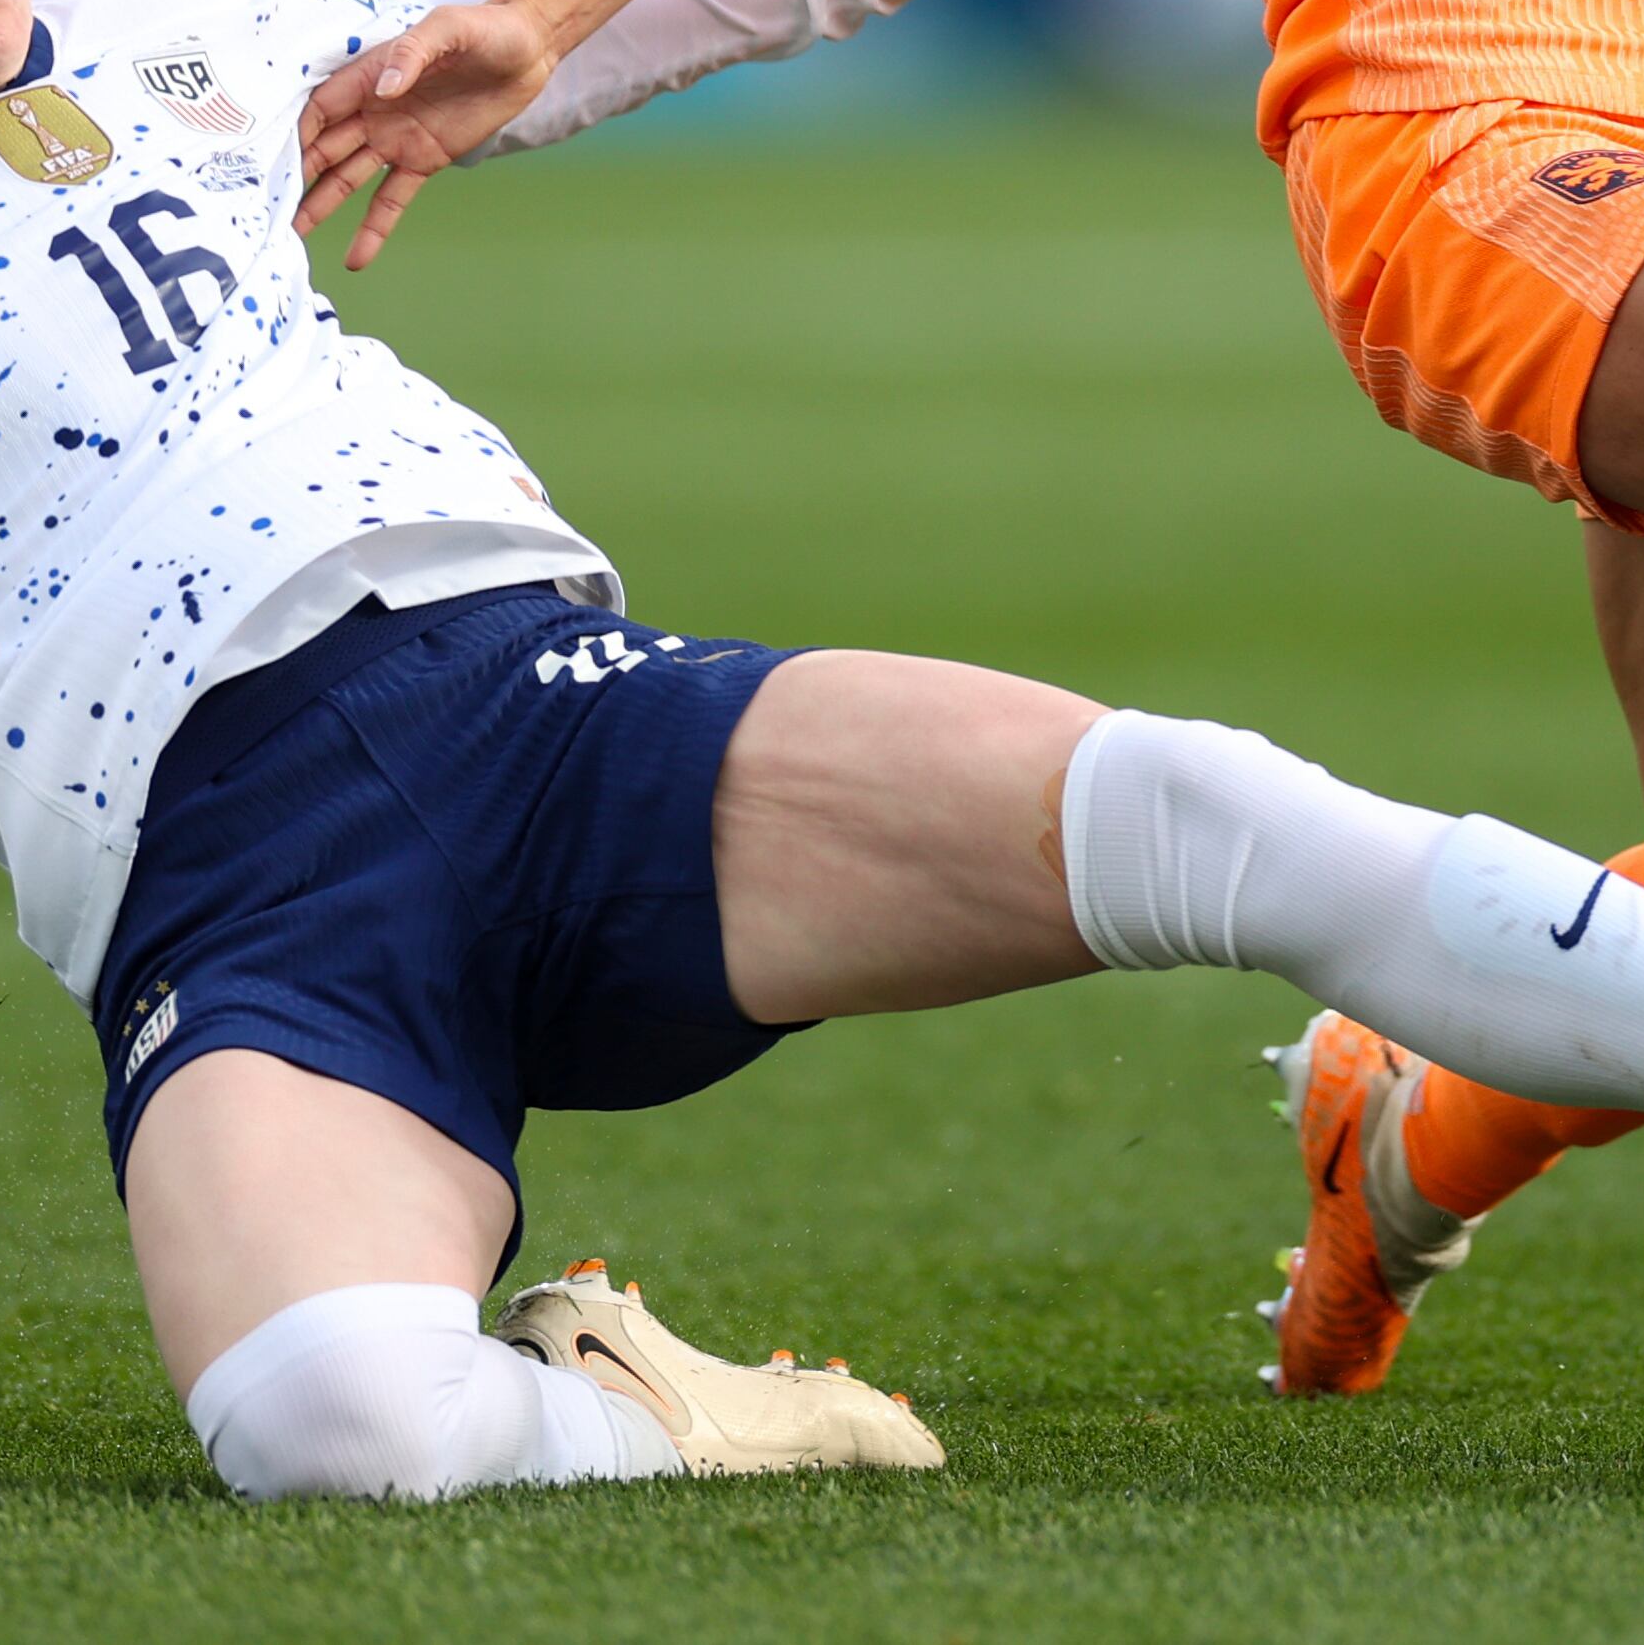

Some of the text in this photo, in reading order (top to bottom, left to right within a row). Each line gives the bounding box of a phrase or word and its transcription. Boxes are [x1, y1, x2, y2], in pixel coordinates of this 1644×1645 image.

[142, 60, 213, 101] USA
[41, 147, 94, 174] FIFA
[47, 189, 238, 375] 16
